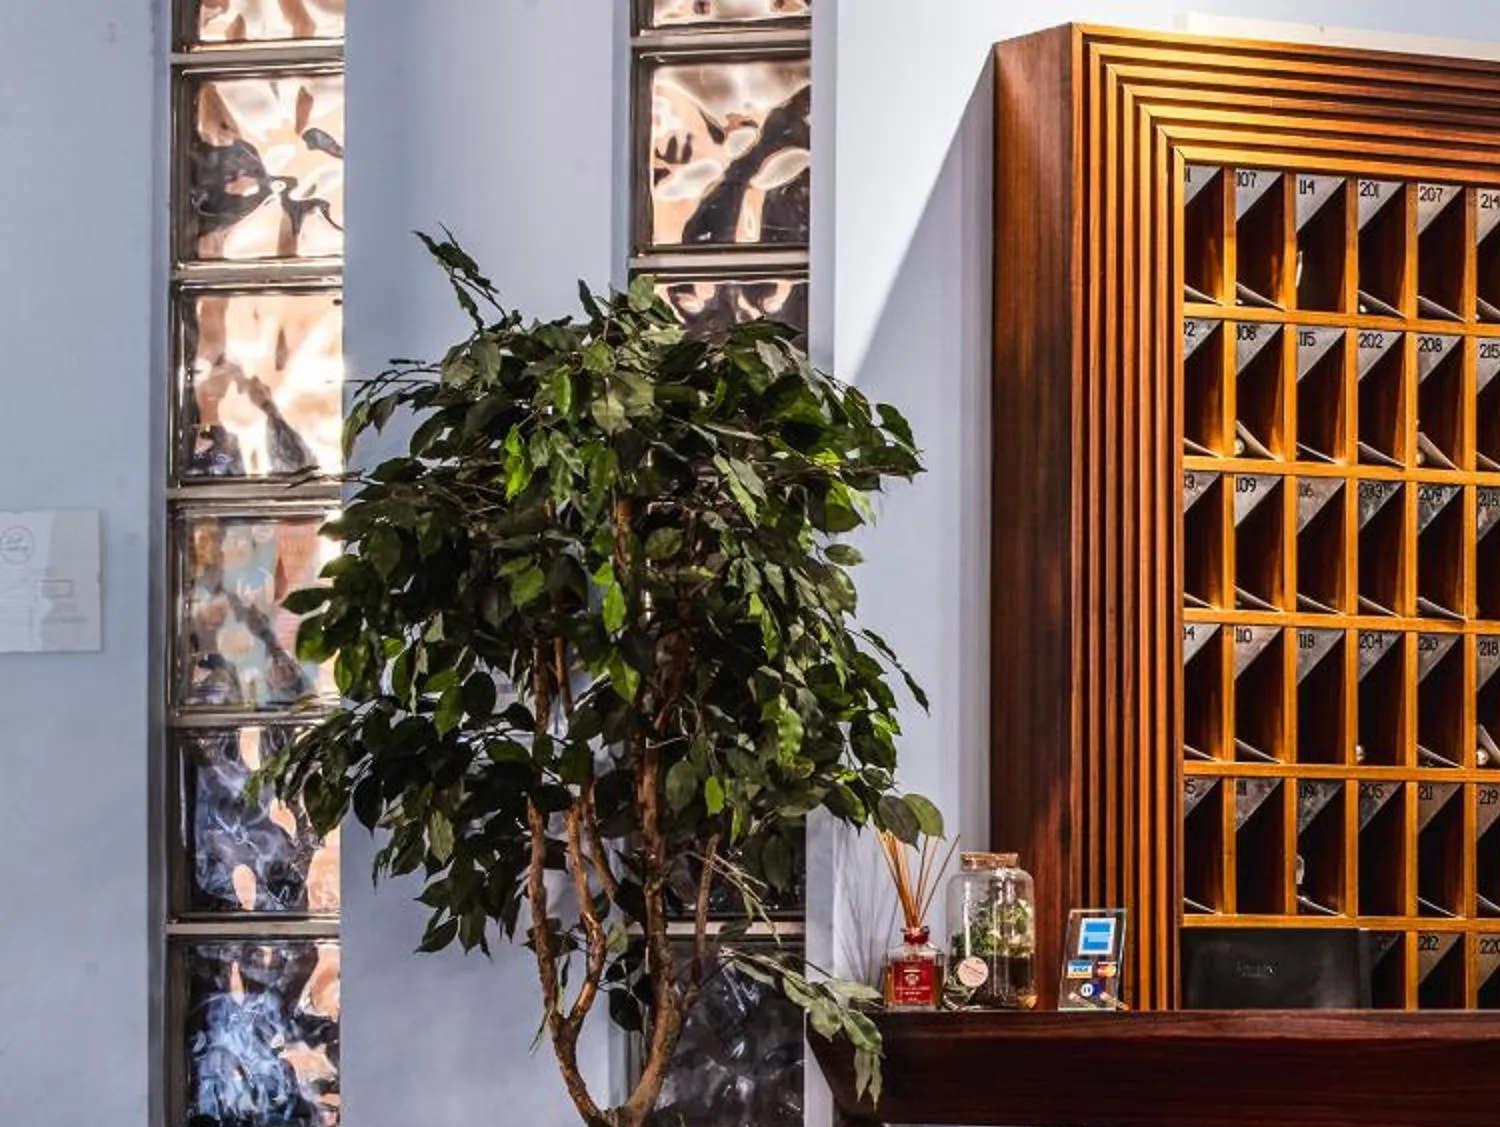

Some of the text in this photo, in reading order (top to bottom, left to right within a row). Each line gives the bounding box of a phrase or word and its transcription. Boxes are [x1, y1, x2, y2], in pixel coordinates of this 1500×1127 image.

[1236, 171, 1257, 189] 107
[1299, 179, 1315, 196] 114
[1360, 182, 1380, 199] 201
[1420, 186, 1443, 203] 207
[1481, 193, 1500, 210] 214
[1299, 331, 1316, 348] 115
[1359, 332, 1384, 349] 202
[1418, 336, 1443, 353] 208
[1480, 343, 1500, 360] 215
[1236, 476, 1257, 493] 109
[1360, 632, 1383, 649] 204
